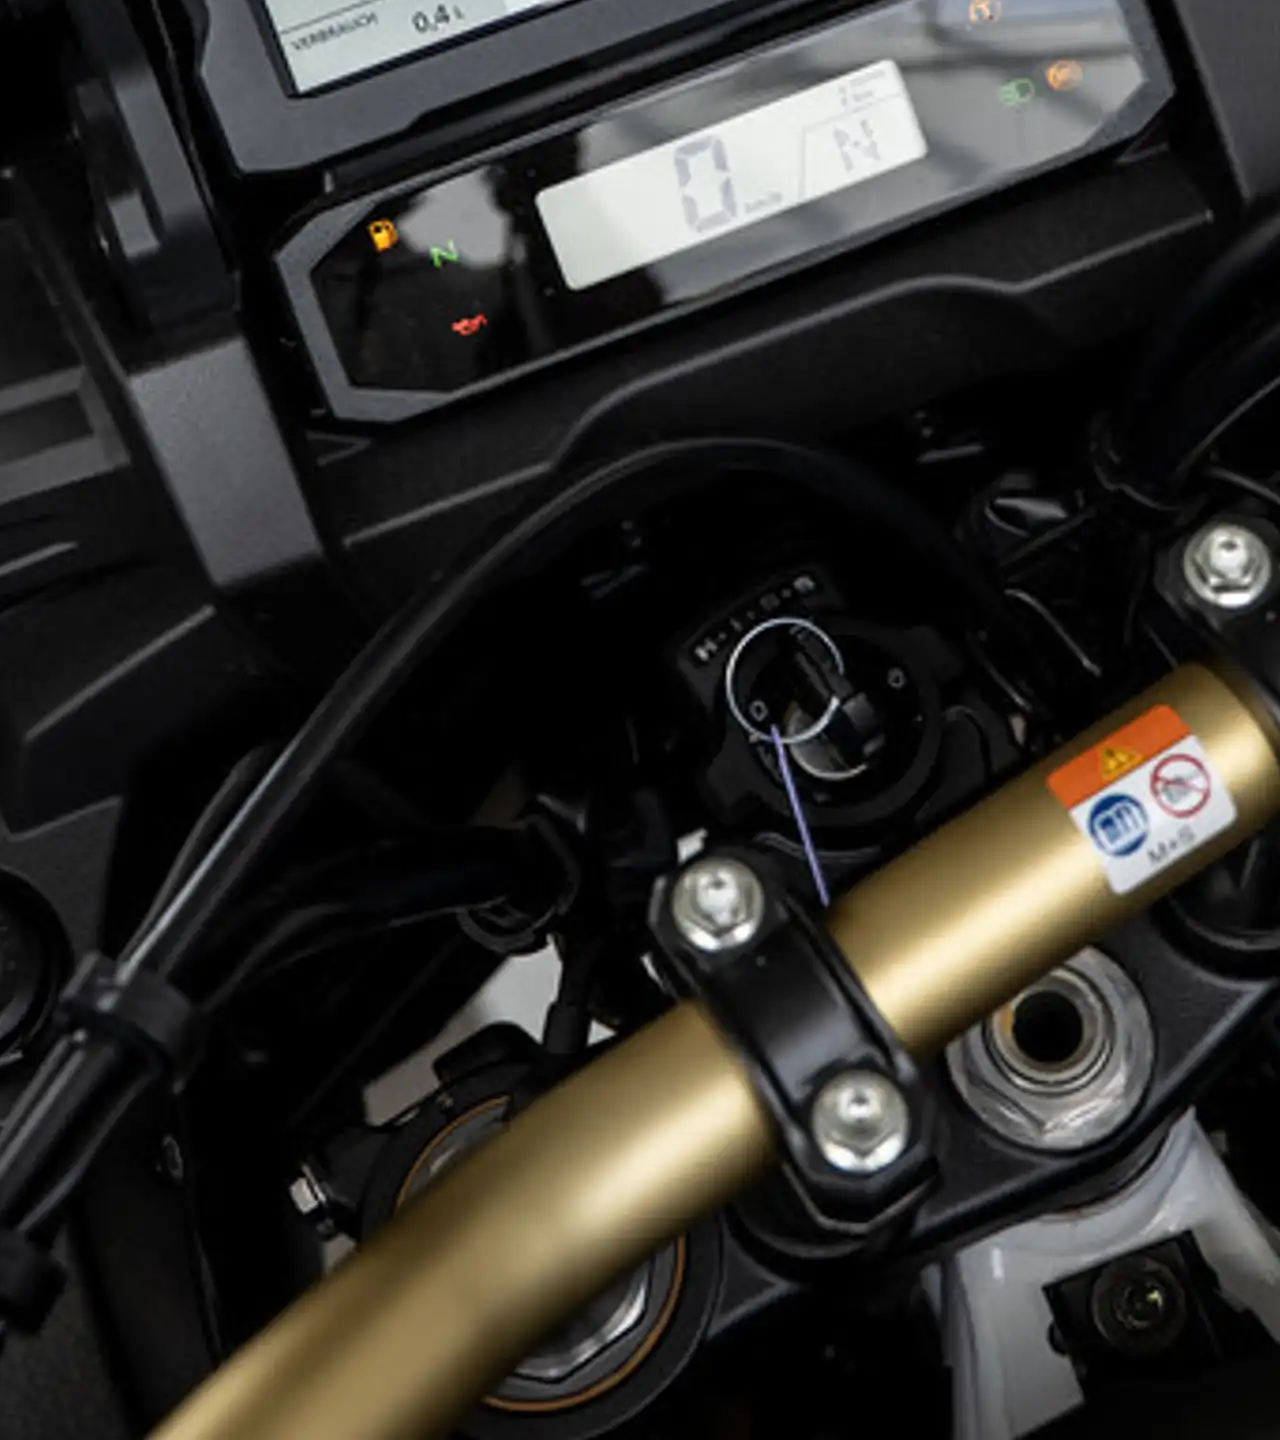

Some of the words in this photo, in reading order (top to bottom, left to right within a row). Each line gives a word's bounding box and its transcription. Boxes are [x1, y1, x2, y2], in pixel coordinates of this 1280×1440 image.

[411, 3, 451, 34] 0,4
[673, 134, 738, 233] 0
[833, 118, 881, 174] N
[429, 239, 458, 268] N
